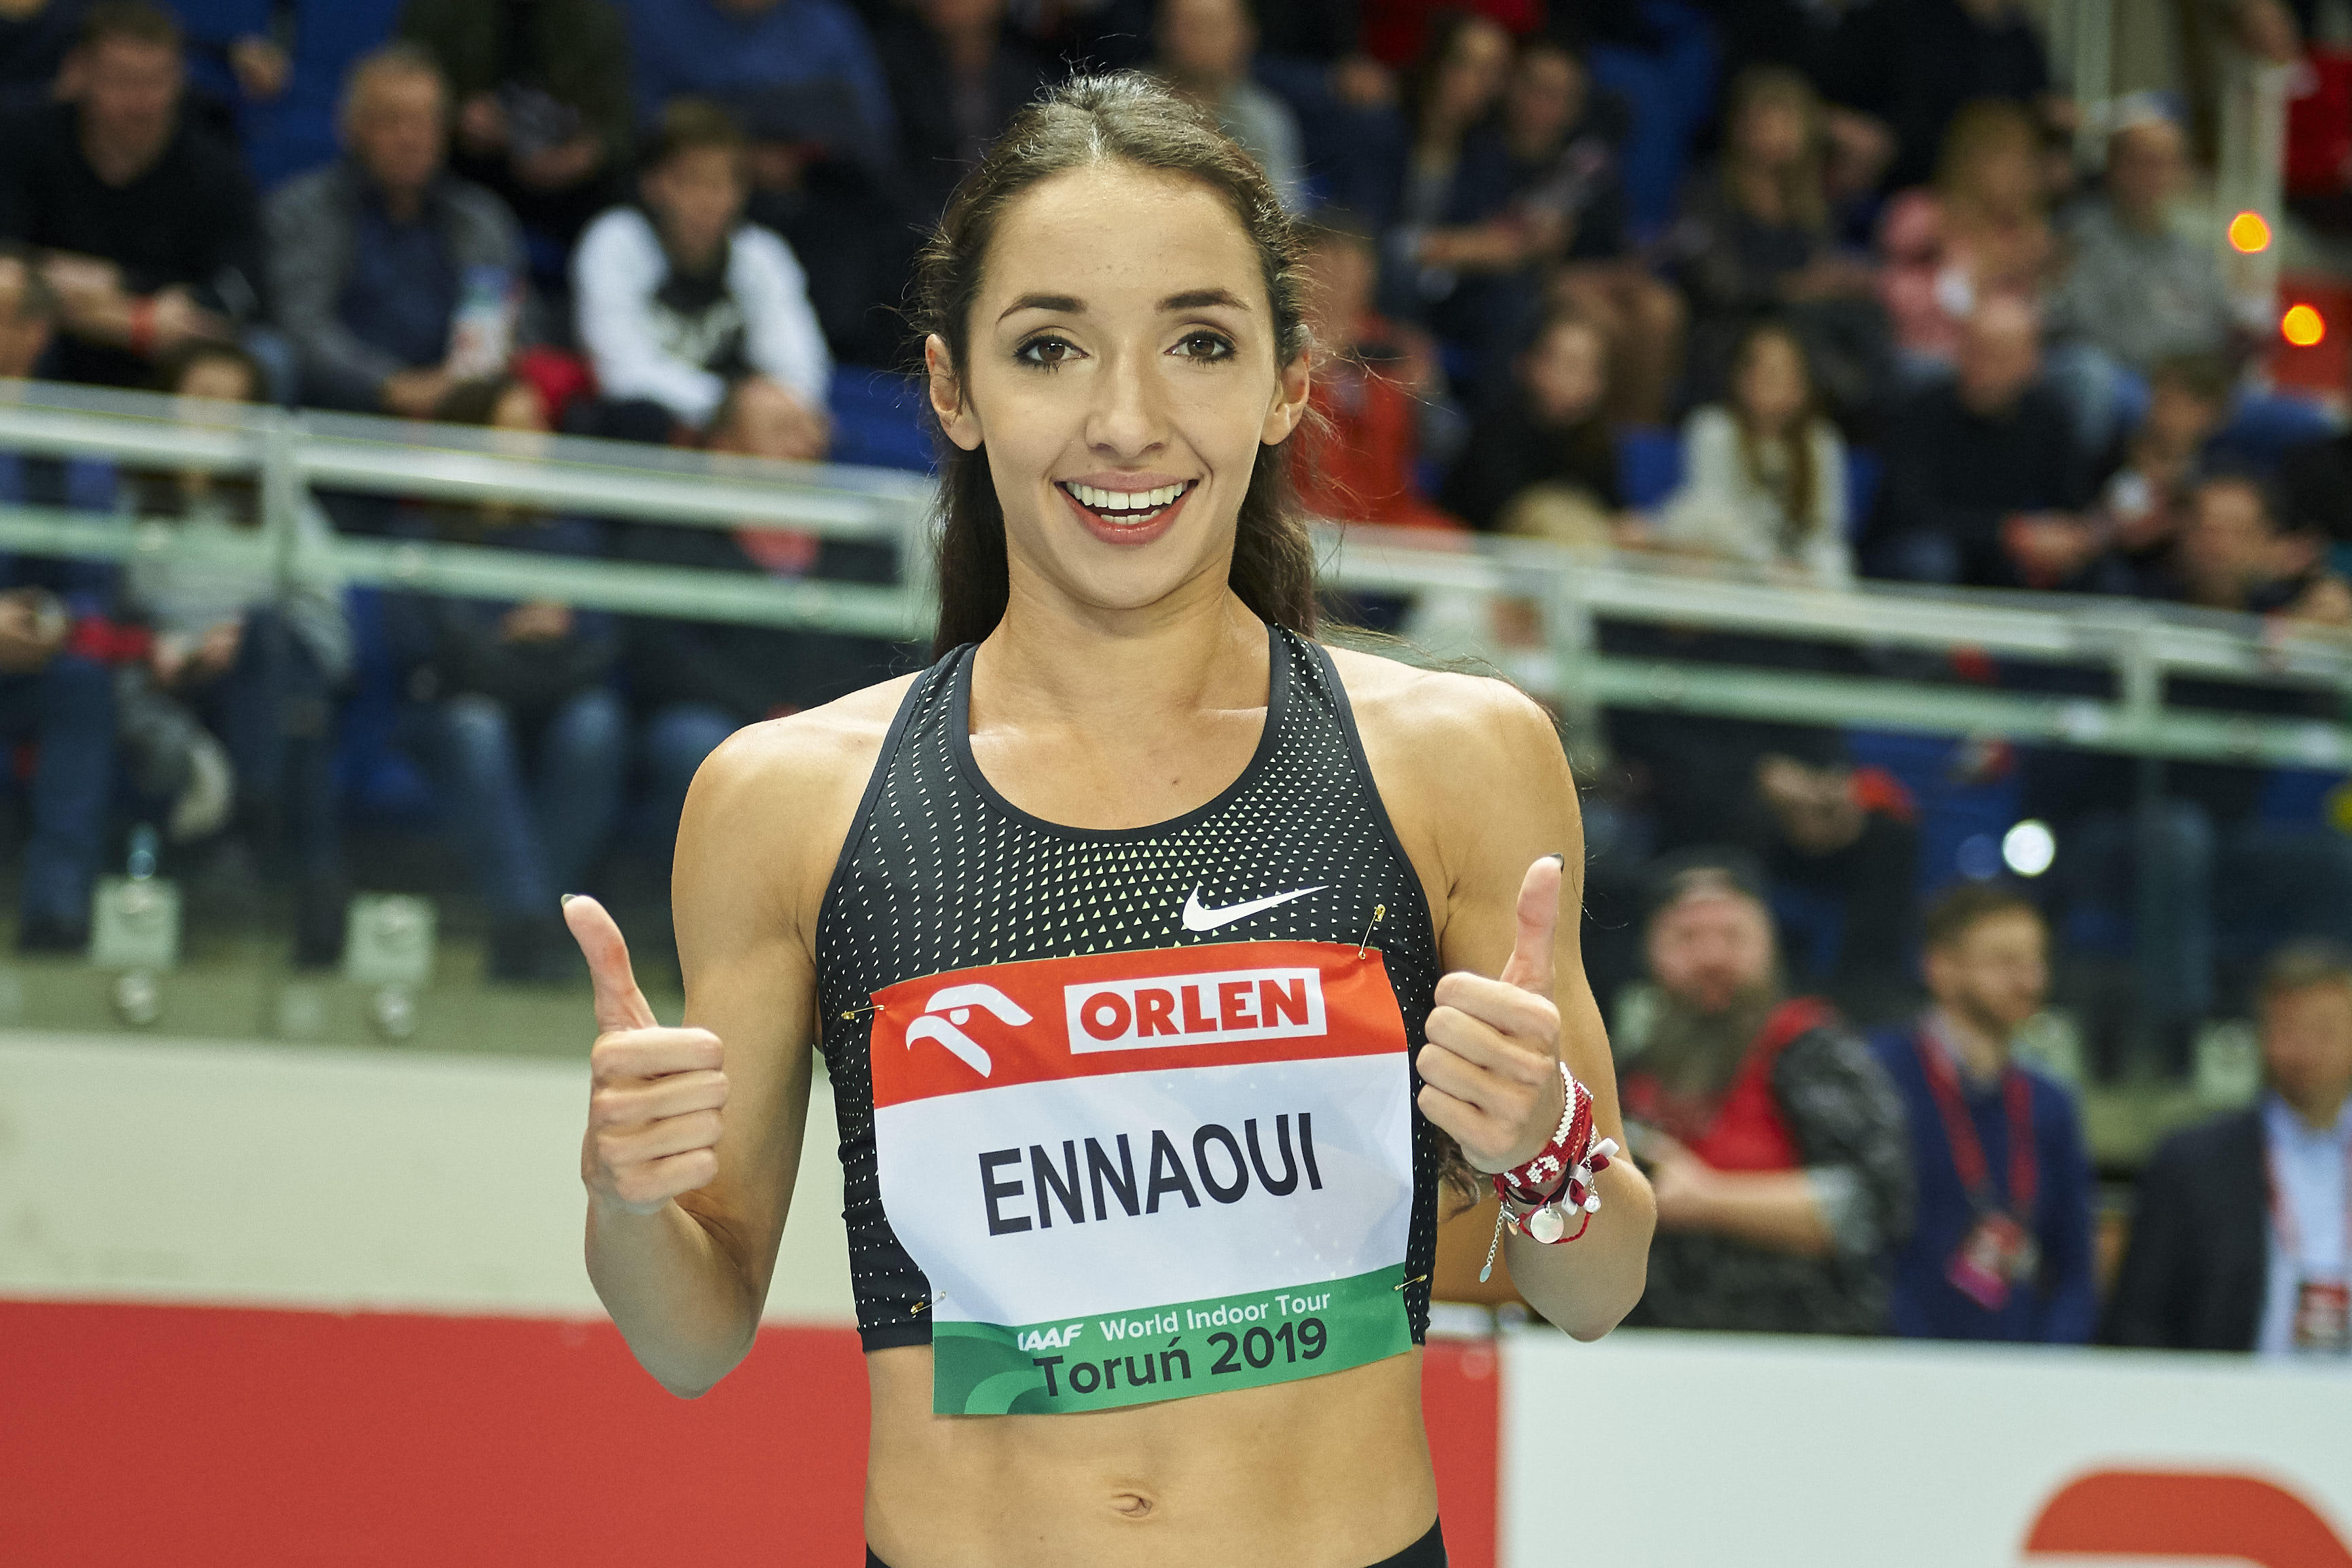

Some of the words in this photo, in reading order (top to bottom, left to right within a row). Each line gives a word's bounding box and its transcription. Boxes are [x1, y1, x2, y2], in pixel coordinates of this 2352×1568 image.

[1081, 979, 1309, 1041] ORLEN
[979, 1112, 1323, 1236] ENNAOUI
[1017, 1324, 1084, 1351] IAAF
[1100, 1313, 1179, 1341] World
[1187, 1302, 1269, 1330] Indoor
[1275, 1292, 1331, 1316] Tour
[1032, 1336, 1192, 1397] Toruń
[1206, 1317, 1327, 1375] 2019
